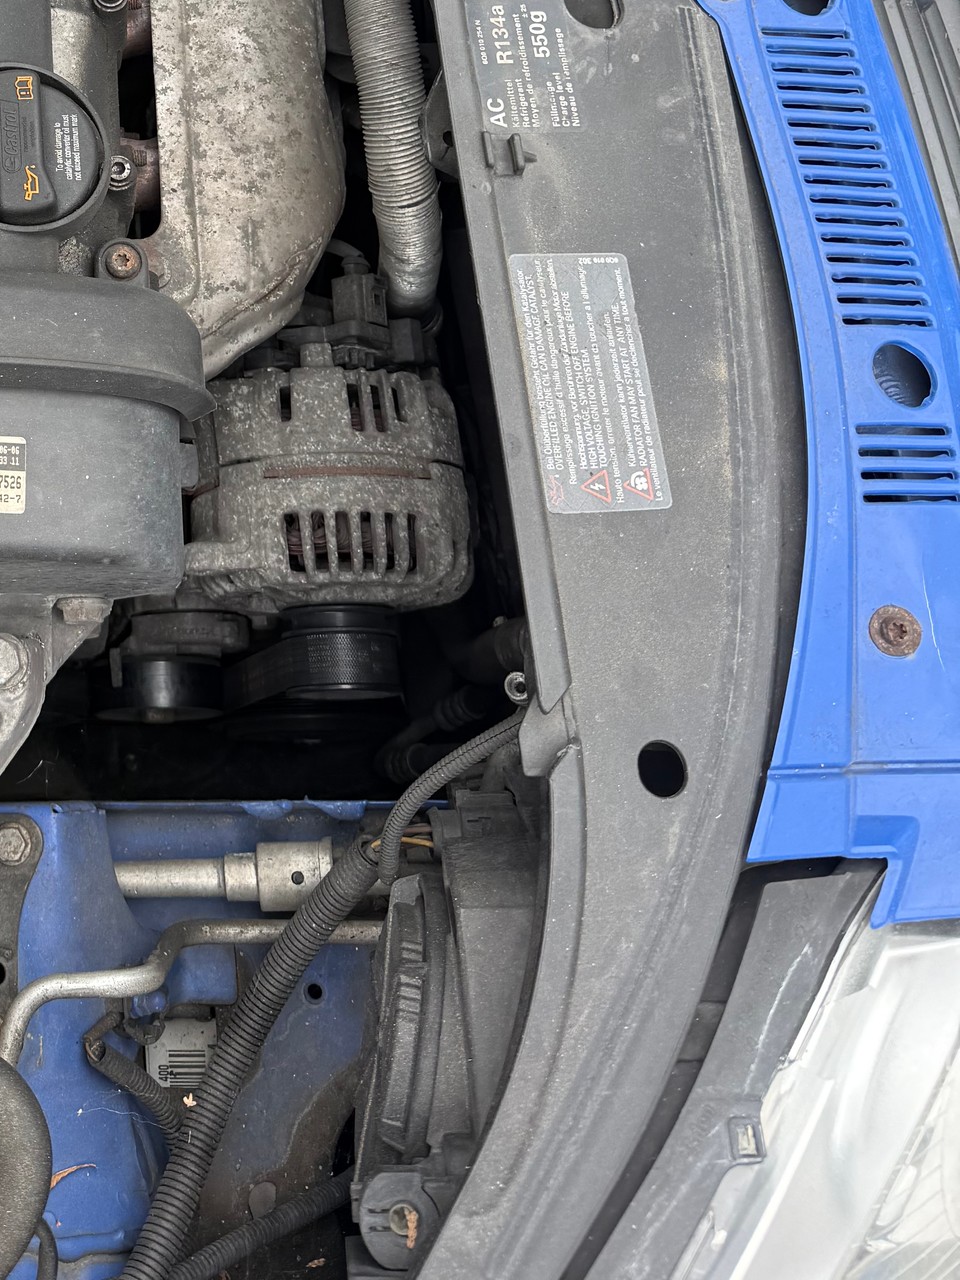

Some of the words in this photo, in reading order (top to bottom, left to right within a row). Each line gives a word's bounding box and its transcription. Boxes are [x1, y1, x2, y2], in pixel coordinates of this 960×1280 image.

[490, 5, 512, 63] R134a
[513, 14, 530, 80] refroidissement
[528, 11, 549, 57] 550g
[526, 83, 534, 94] de
[552, 72, 563, 92] level
[565, 82, 573, 93] de
[487, 98, 507, 127] AC
[504, 79, 519, 127] Kältemittel
[515, 78, 529, 127] Refrigerant
[529, 97, 541, 127] Moyen
[569, 96, 579, 126] Niveau
[0, 109, 22, 155] Castrol
[61, 114, 69, 126] must
[63, 134, 71, 157] converter
[71, 127, 79, 151] maximum
[54, 149, 63, 163] avoid
[64, 158, 73, 179] catalytic
[72, 152, 80, 170] exceed
[516, 268, 530, 311] Katalysator.
[524, 274, 538, 313] CATALYST.
[614, 267, 624, 298] moment.
[551, 290, 561, 311] Motor
[560, 291, 572, 321] BEFORE
[611, 302, 620, 323] TIME.
[619, 300, 628, 315] tout
[523, 313, 531, 327] den
[542, 309, 553, 326] pour
[586, 312, 596, 341] toucher
[556, 312, 568, 352] Zündanlage
[566, 323, 578, 353] ENGINE
[615, 326, 625, 343] ANY
[625, 324, 638, 366] declencher
[528, 342, 538, 368] Gefahr
[546, 327, 558, 368] dangereux
[562, 353, 570, 365] der
[591, 343, 598, 353] de
[618, 346, 628, 356] AT
[537, 352, 547, 370] CAN
[571, 355, 581, 370] OFF
[593, 354, 602, 376] avant
[609, 348, 623, 382] jederzeit
[621, 359, 632, 384] START
[532, 370, 543, 399] besteht
[540, 372, 550, 385] OIL
[565, 366, 576, 399] Berühren
[575, 371, 587, 405] SWITCH
[634, 379, 646, 396] peut
[543, 387, 555, 419] ENGINE
[586, 384, 599, 421] IGNITION
[597, 378, 607, 406] moteur
[616, 383, 624, 402] kann
[626, 385, 636, 404] MAY
[556, 399, 568, 432] excessif
[570, 401, 578, 412] vor
[602, 407, 609, 415] le
[629, 406, 639, 422] FAN
[639, 399, 650, 434] radiateur
[604, 417, 614, 444] arreter
[620, 405, 635, 466] Kühlerventilator
[645, 435, 652, 446] de
[549, 421, 563, 470] OVERFILLED
[587, 447, 598, 468] HIGH
[593, 424, 607, 467] TOUCHING
[633, 424, 647, 466] RADIATOR
[545, 456, 554, 469] Bei
[564, 434, 576, 484] Remplissage
[647, 448, 660, 489] ventilateur
[655, 490, 663, 500] Le
[158, 1065, 169, 1081] 400
